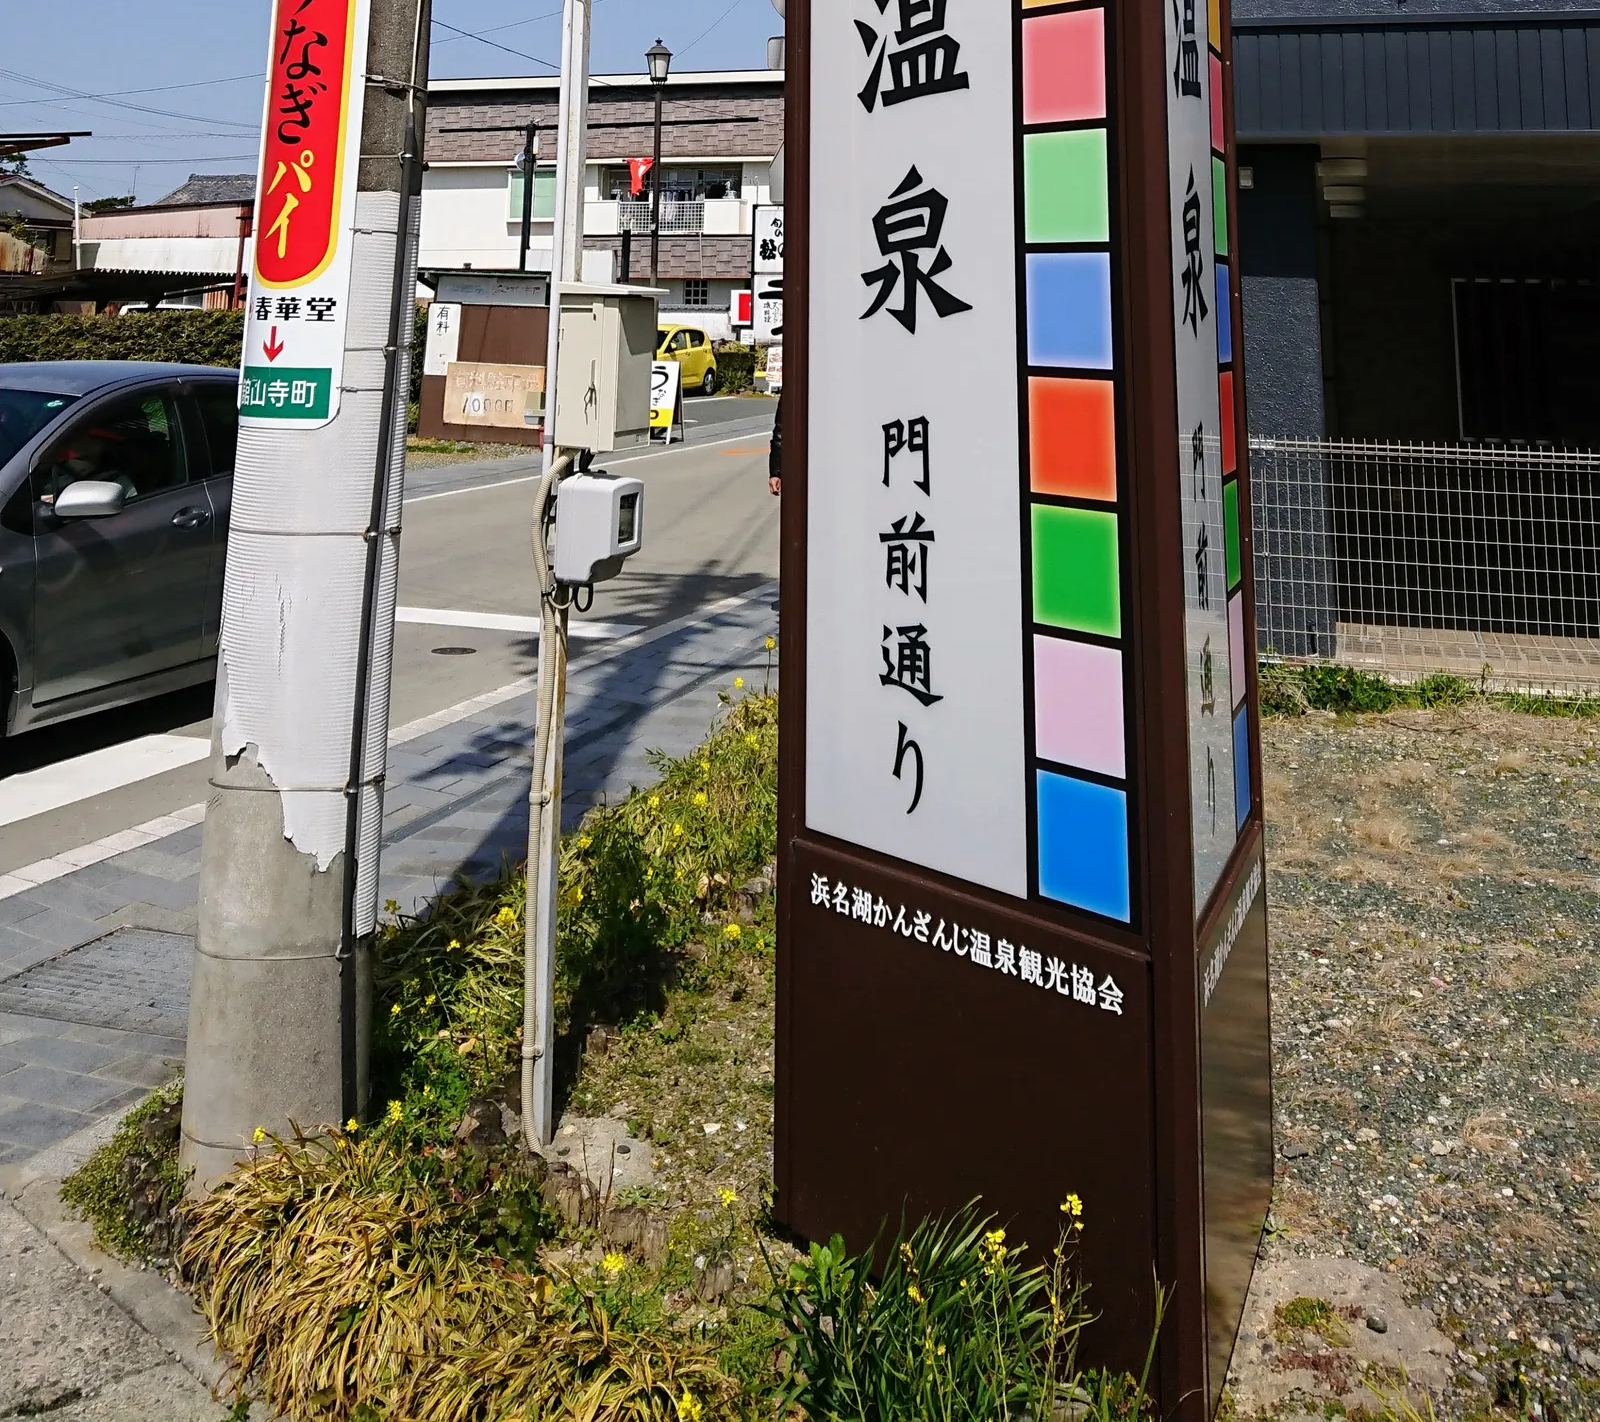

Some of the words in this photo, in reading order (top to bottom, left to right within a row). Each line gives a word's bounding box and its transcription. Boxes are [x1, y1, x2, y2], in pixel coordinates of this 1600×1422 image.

[255, 296, 337, 322] 春華堂
[879, 415, 943, 814] 門前通り
[810, 872, 1125, 1016] 浜名湖かんざんじ温泉観光協会
